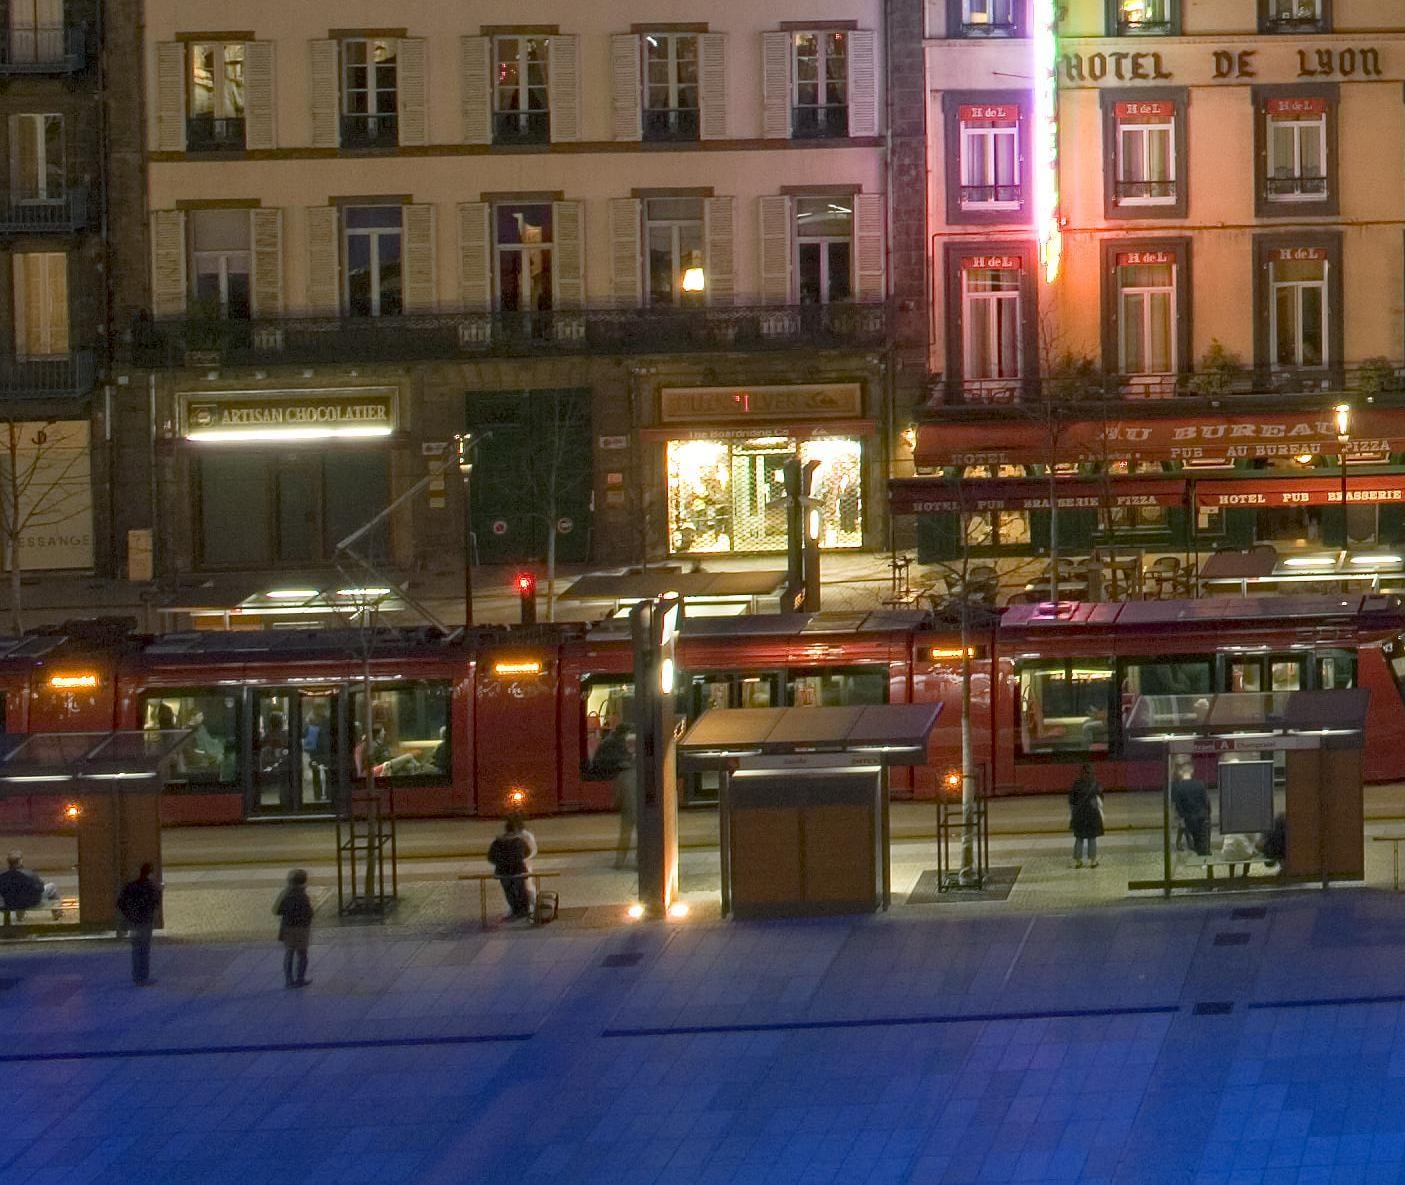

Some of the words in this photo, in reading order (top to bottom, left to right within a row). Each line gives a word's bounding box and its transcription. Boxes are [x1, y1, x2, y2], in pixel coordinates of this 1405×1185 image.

[1063, 51, 1172, 81] HOTEL
[1212, 50, 1257, 79] DE
[1126, 105, 1138, 114] H
[1279, 102, 1289, 111] H
[971, 109, 983, 118] H
[1128, 253, 1141, 263] H
[1280, 249, 1292, 260] H
[973, 257, 985, 267] H
[221, 408, 282, 425] ARTISAN
[285, 405, 387, 423] CHOCOLATIER
[1172, 420, 1337, 440] BUREAU
[952, 452, 1008, 465] HOTEL
[1171, 447, 1204, 459] PUB
[1227, 445, 1247, 457] AU
[1256, 444, 1320, 455] BUREAU
[1344, 440, 1390, 452] PIZZA
[913, 501, 961, 512] HOTEL
[978, 499, 1005, 510] PUB
[1024, 496, 1099, 508] BRASERIE
[1117, 495, 1157, 506] PIZZA
[1219, 493, 1266, 505] HOTEL
[1283, 491, 1309, 503] PUB
